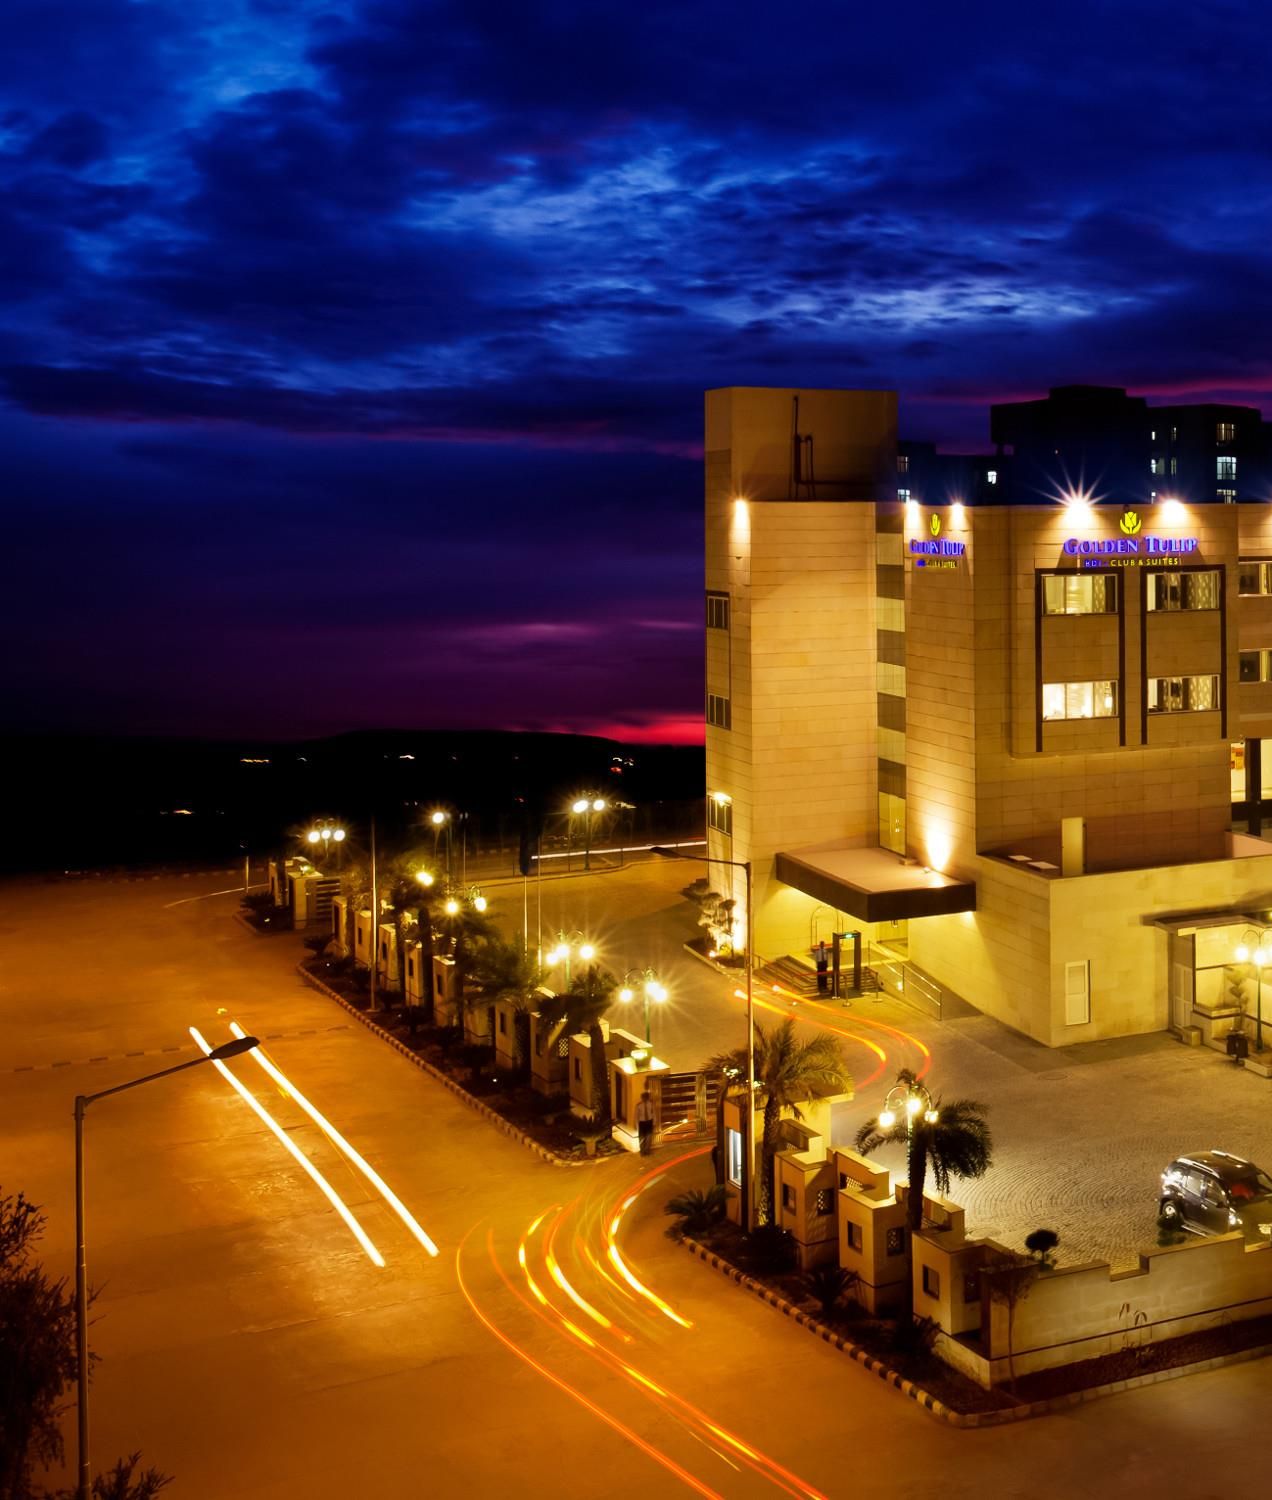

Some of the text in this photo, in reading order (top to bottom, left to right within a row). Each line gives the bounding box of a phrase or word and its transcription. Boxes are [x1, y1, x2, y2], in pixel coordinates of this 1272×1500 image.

[909, 538, 965, 555] GOLDEN TULIP
[1064, 536, 1197, 554] GOLDEN TULIP
[1110, 559, 1135, 567] CLUB
[1138, 559, 1144, 567] &
[1146, 558, 1179, 566] SUITES
